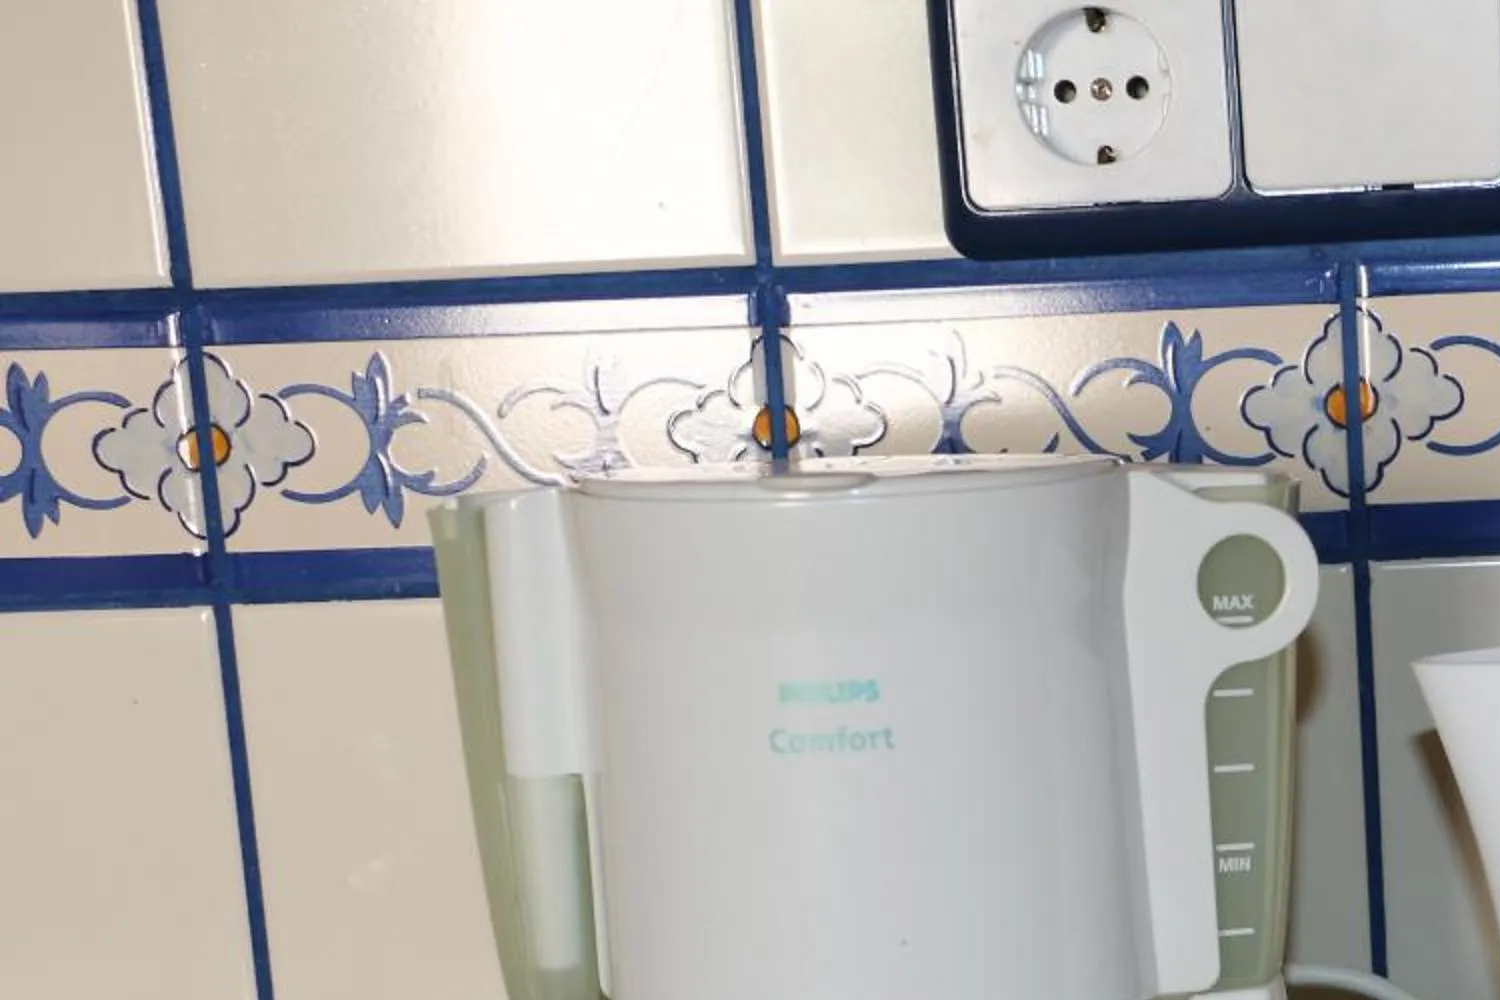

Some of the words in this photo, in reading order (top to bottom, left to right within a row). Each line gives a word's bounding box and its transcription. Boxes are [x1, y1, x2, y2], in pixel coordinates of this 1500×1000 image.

[1212, 595, 1255, 611] MAX
[768, 726, 897, 755] Comfort
[1217, 857, 1252, 872] MIN
